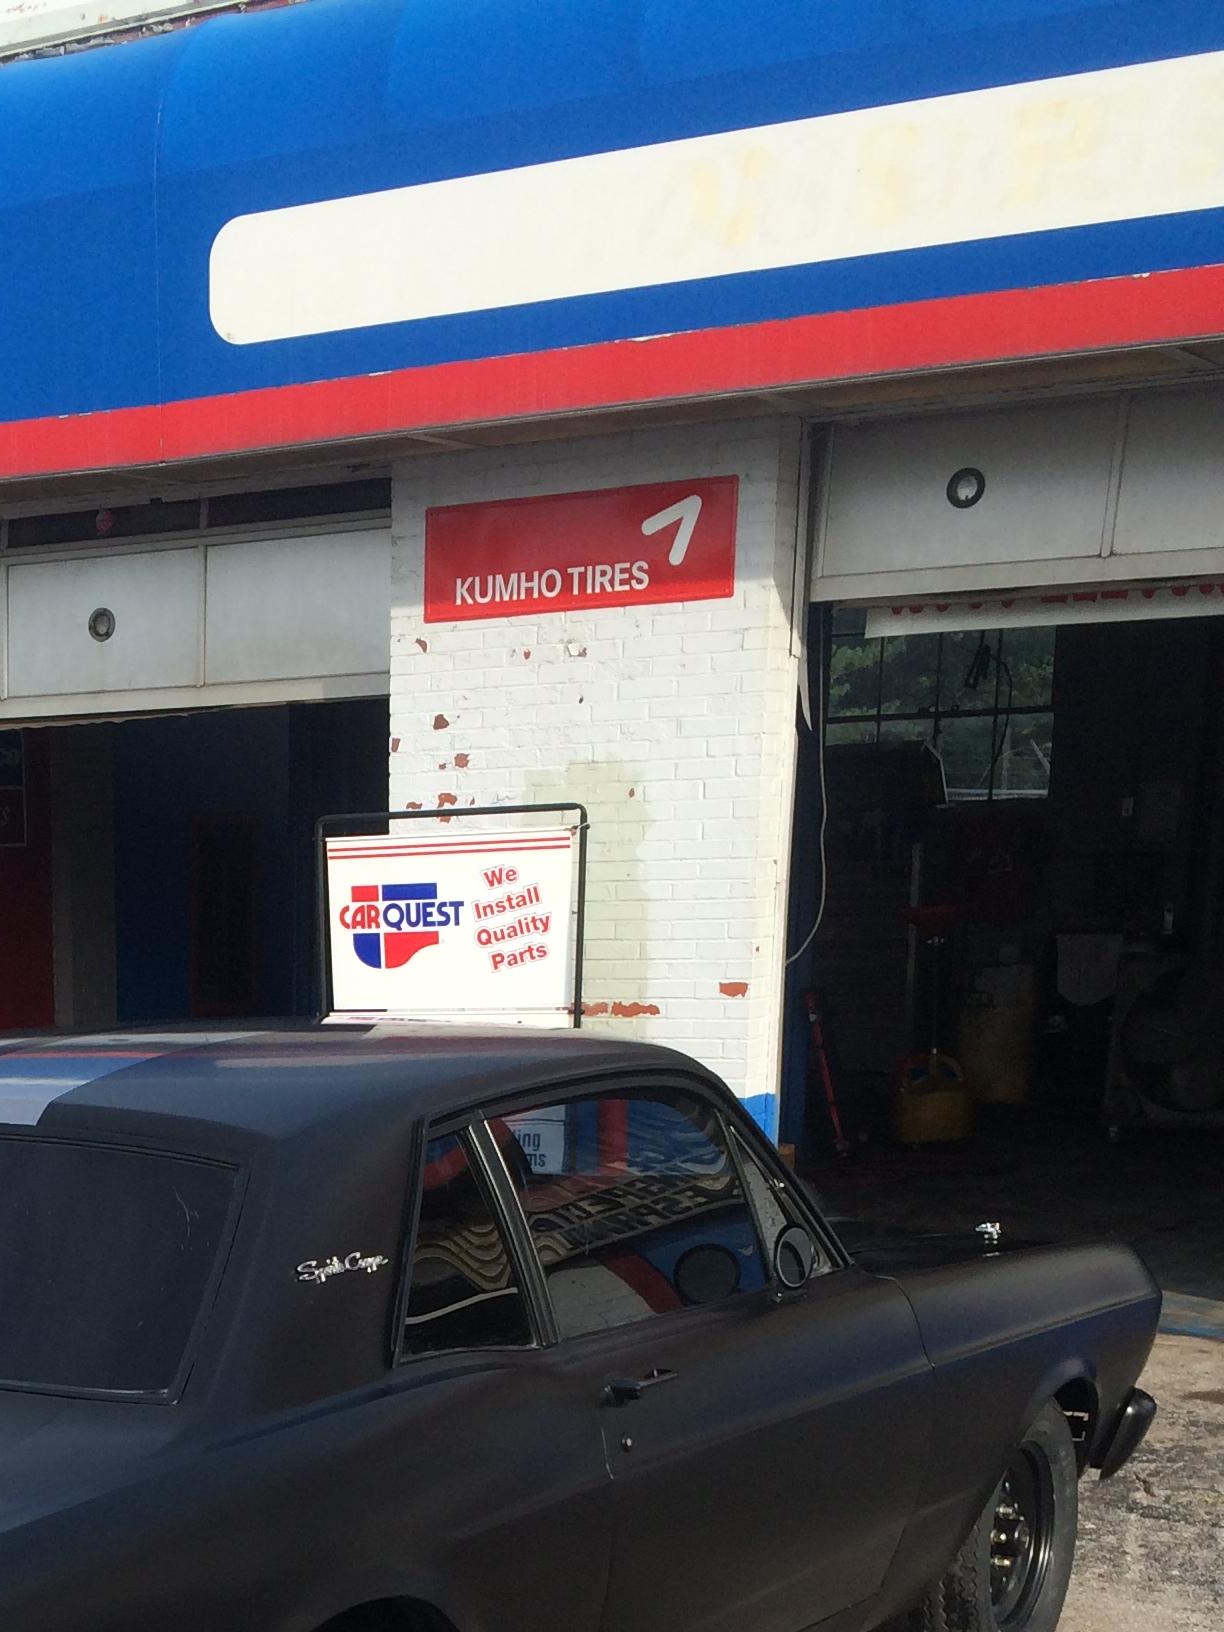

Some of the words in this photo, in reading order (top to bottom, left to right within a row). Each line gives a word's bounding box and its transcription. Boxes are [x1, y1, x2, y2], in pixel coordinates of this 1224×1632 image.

[455, 568, 562, 606] KUMHO
[567, 560, 650, 596] TIRES
[483, 866, 518, 888] We
[339, 900, 465, 931] CARQUEST
[473, 886, 541, 919] Install
[476, 914, 551, 946] Quality
[491, 944, 548, 971] Parts
